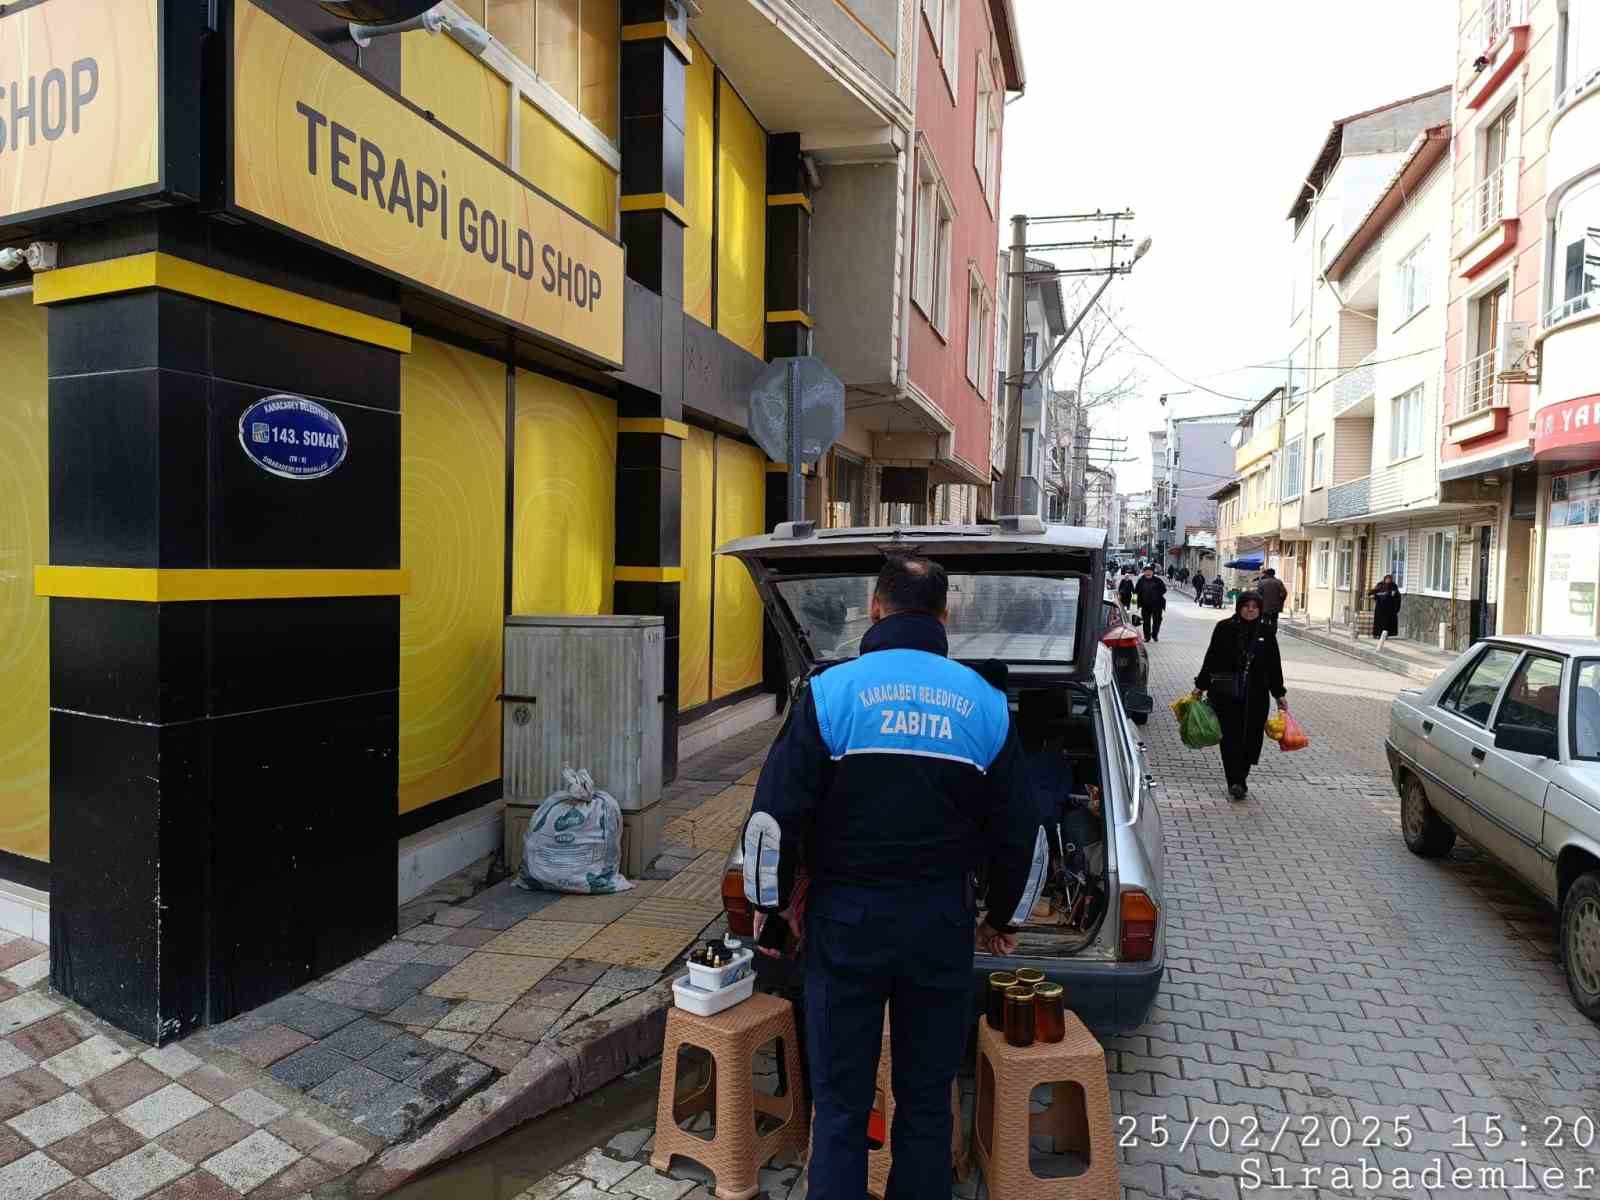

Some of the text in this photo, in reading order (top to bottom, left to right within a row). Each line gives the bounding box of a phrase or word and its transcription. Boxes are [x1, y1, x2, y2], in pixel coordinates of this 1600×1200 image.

[0, 57, 99, 154] HOP
[459, 197, 534, 281] GOLD
[541, 244, 602, 312] SHOP
[271, 426, 340, 449] 143. SOKAK
[858, 683, 917, 708] KARACABEY
[879, 709, 953, 739] ZABITA
